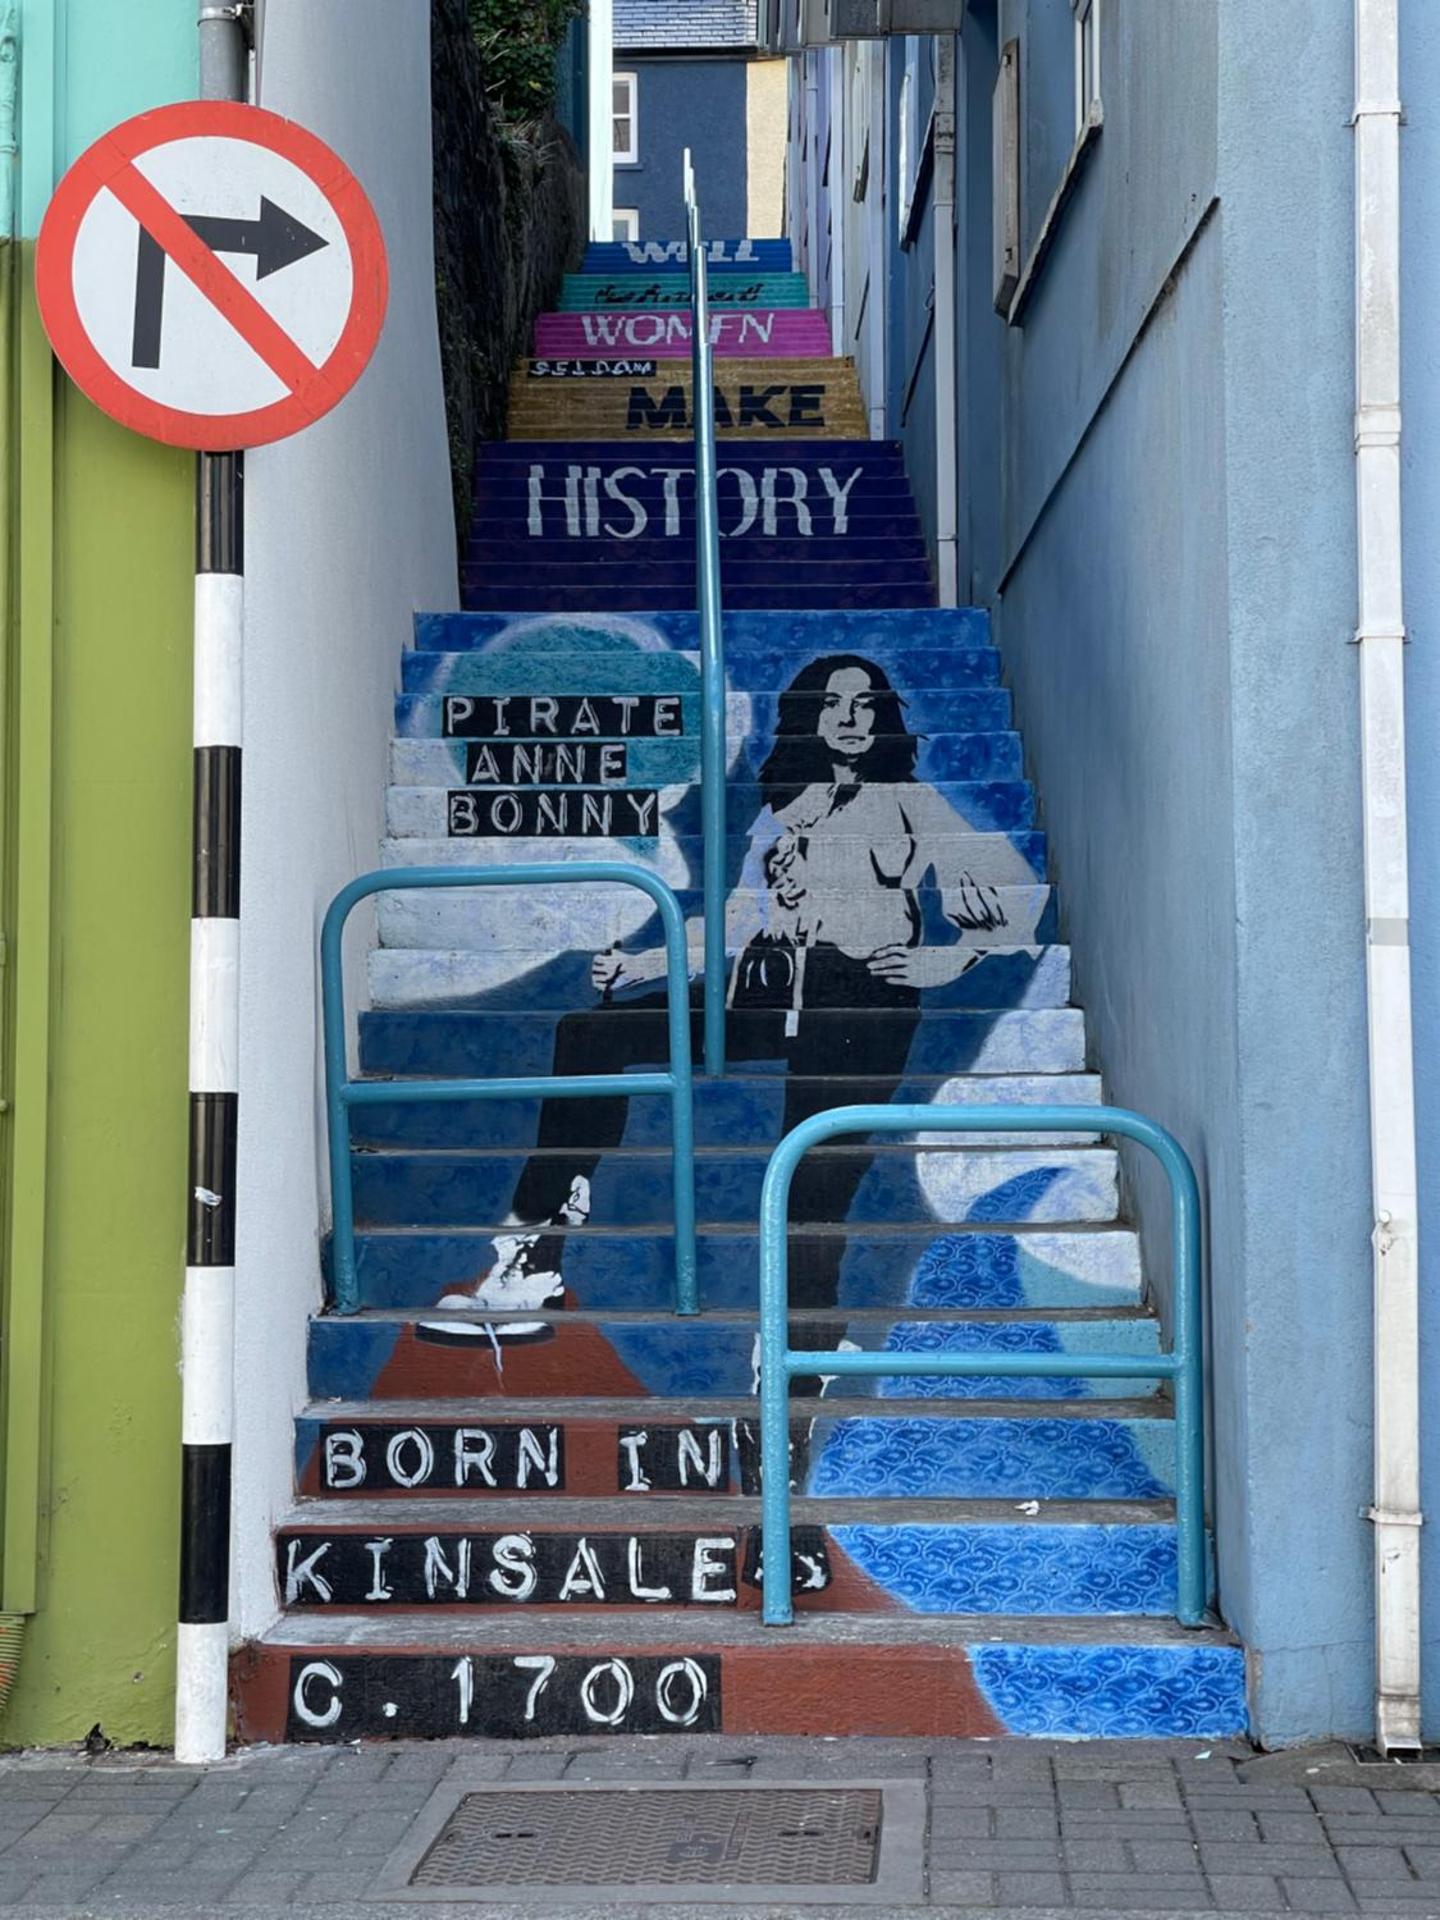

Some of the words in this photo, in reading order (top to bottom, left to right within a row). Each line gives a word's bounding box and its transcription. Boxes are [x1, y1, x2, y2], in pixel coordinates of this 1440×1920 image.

[531, 360, 650, 375] SELDOM
[625, 385, 825, 430] MAKE
[527, 464, 863, 538] HISTORY
[447, 696, 680, 736] PIRATE
[471, 744, 626, 784] ANNE
[450, 792, 656, 835] BONNY
[326, 1426, 559, 1488] BORN
[620, 1429, 722, 1492] IN
[285, 1531, 736, 1602] KINSALE
